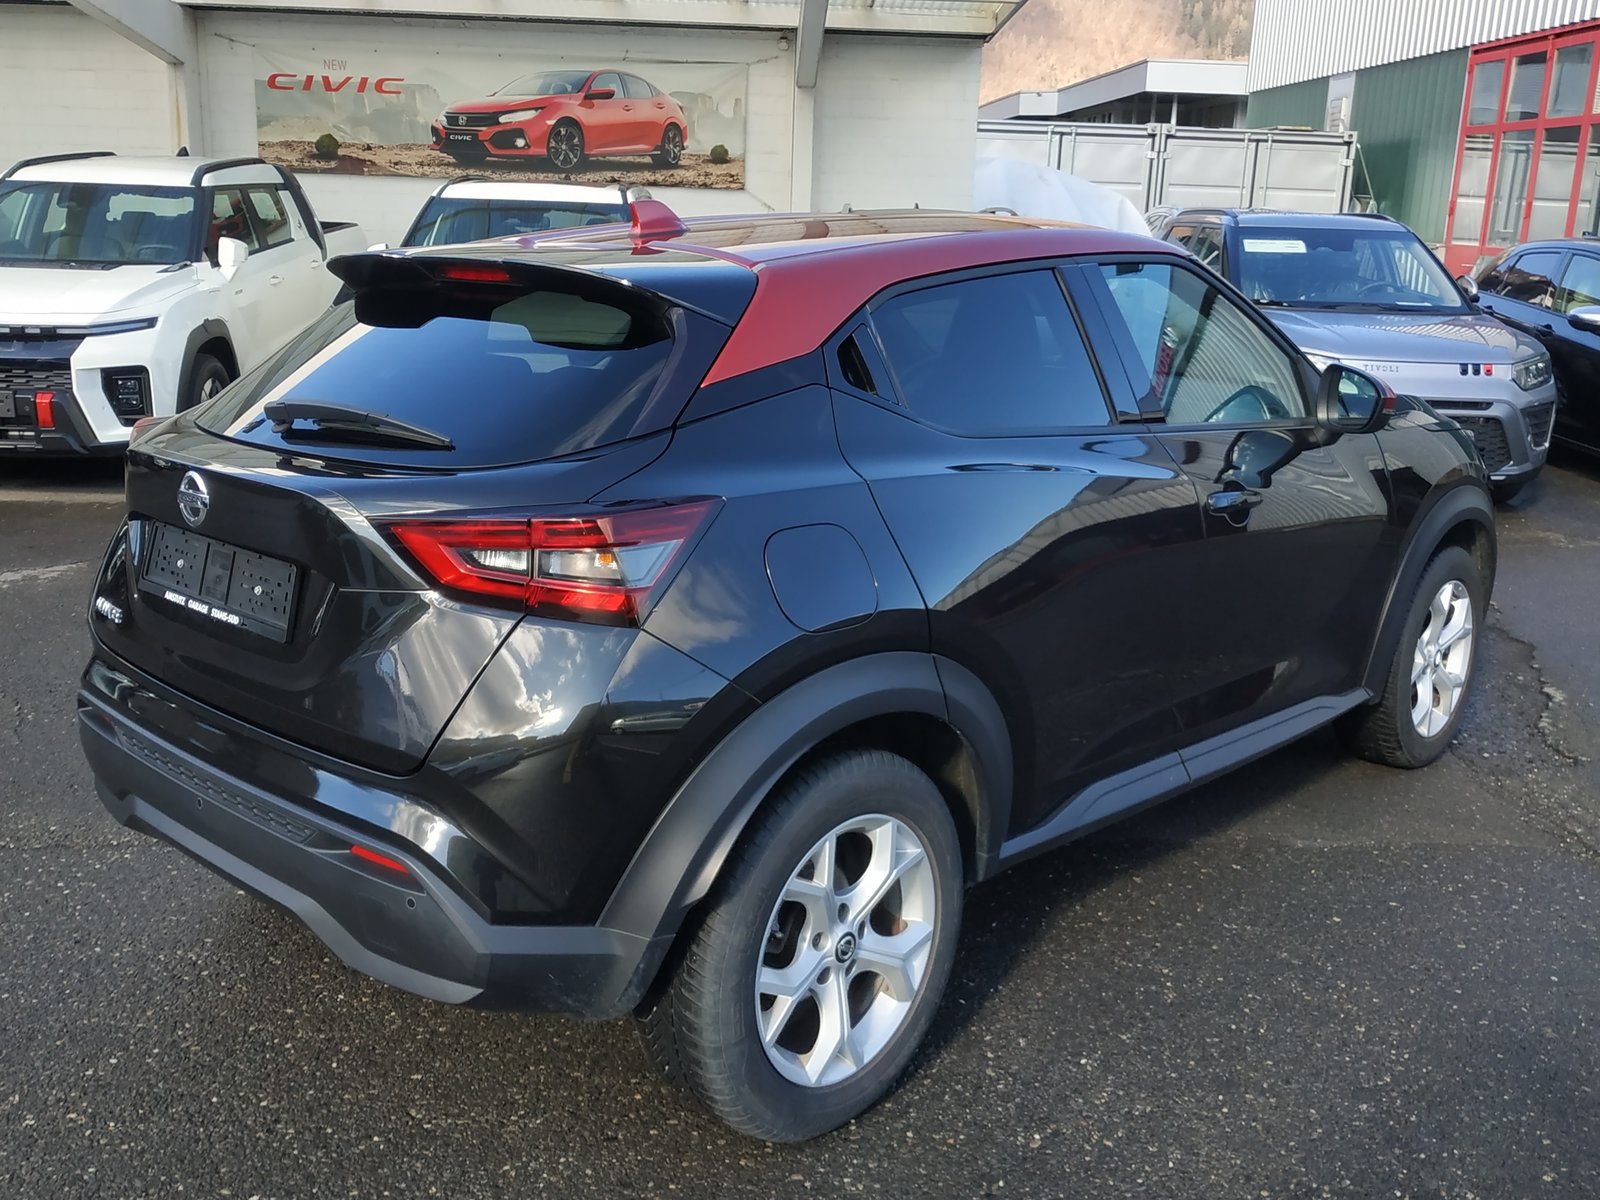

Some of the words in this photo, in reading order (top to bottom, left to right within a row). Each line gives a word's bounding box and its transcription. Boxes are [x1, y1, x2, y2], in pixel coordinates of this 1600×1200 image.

[322, 59, 347, 71] NEW
[266, 73, 405, 95] CIVIC
[1363, 364, 1399, 373] TIVOLI
[187, 599, 209, 615] GARAGE
